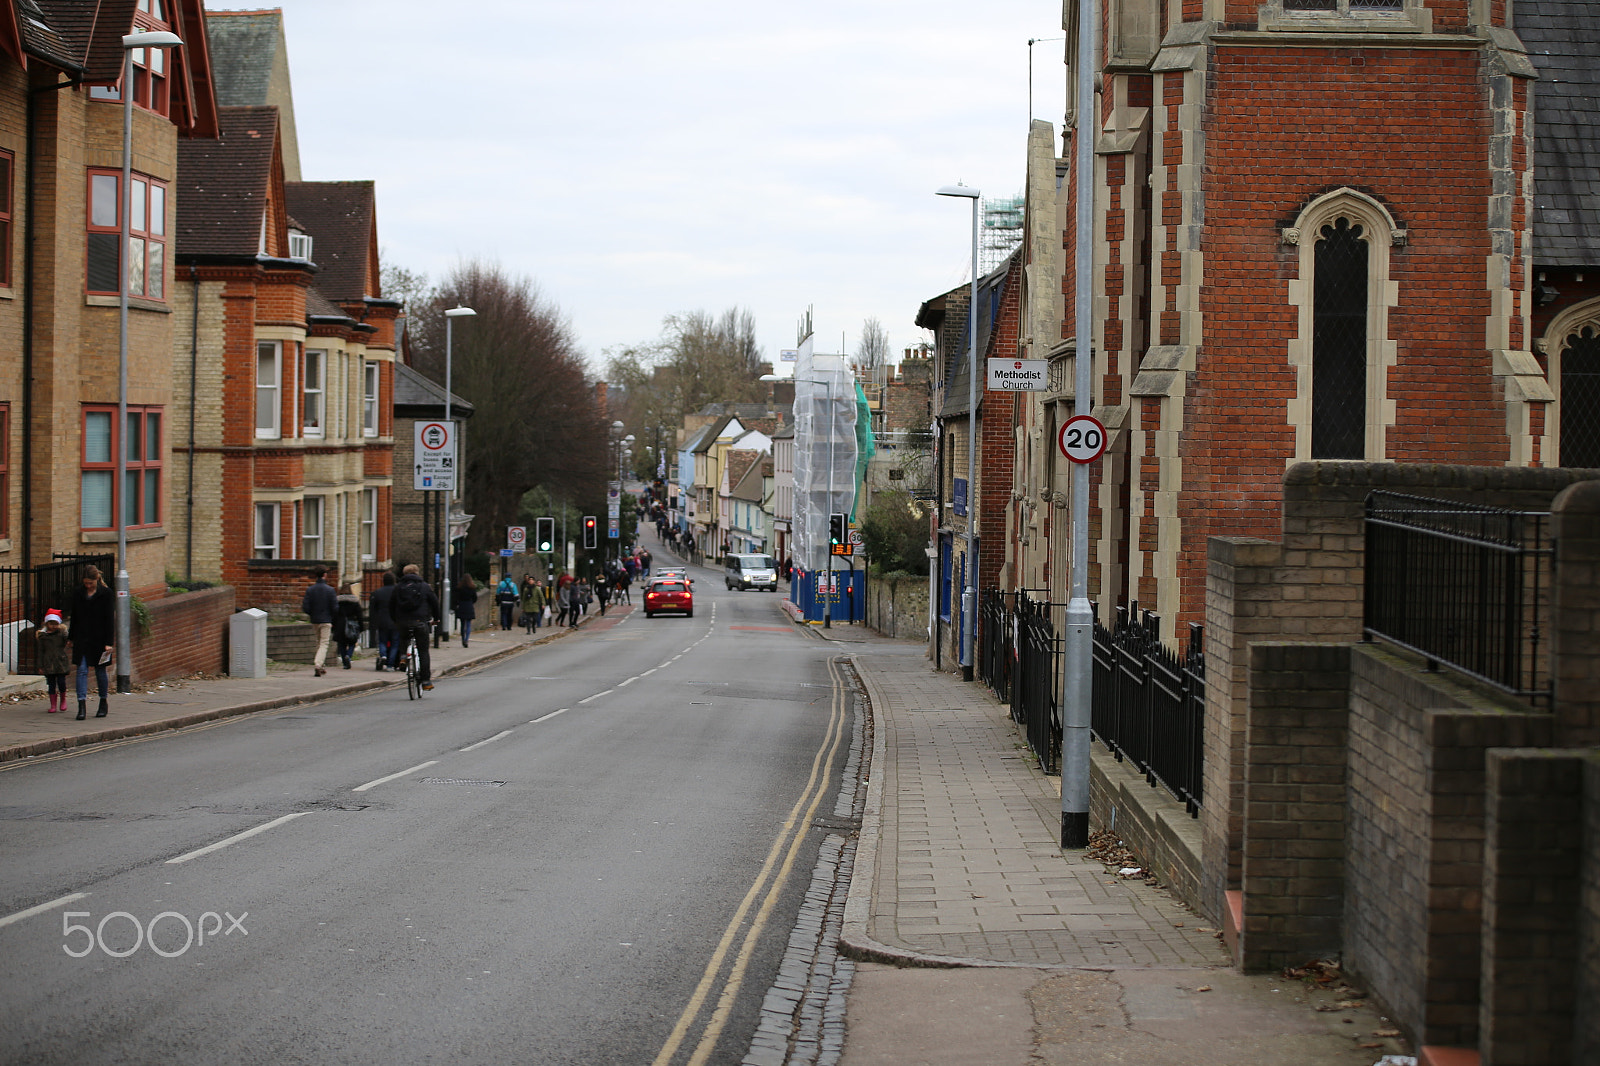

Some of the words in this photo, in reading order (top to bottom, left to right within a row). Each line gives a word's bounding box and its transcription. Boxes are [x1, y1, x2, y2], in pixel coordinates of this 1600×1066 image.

[994, 370, 1041, 379] Methodist
[1002, 380, 1034, 389] Church
[1067, 428, 1101, 449] 20
[512, 531, 523, 539] 30
[851, 534, 862, 542] 30
